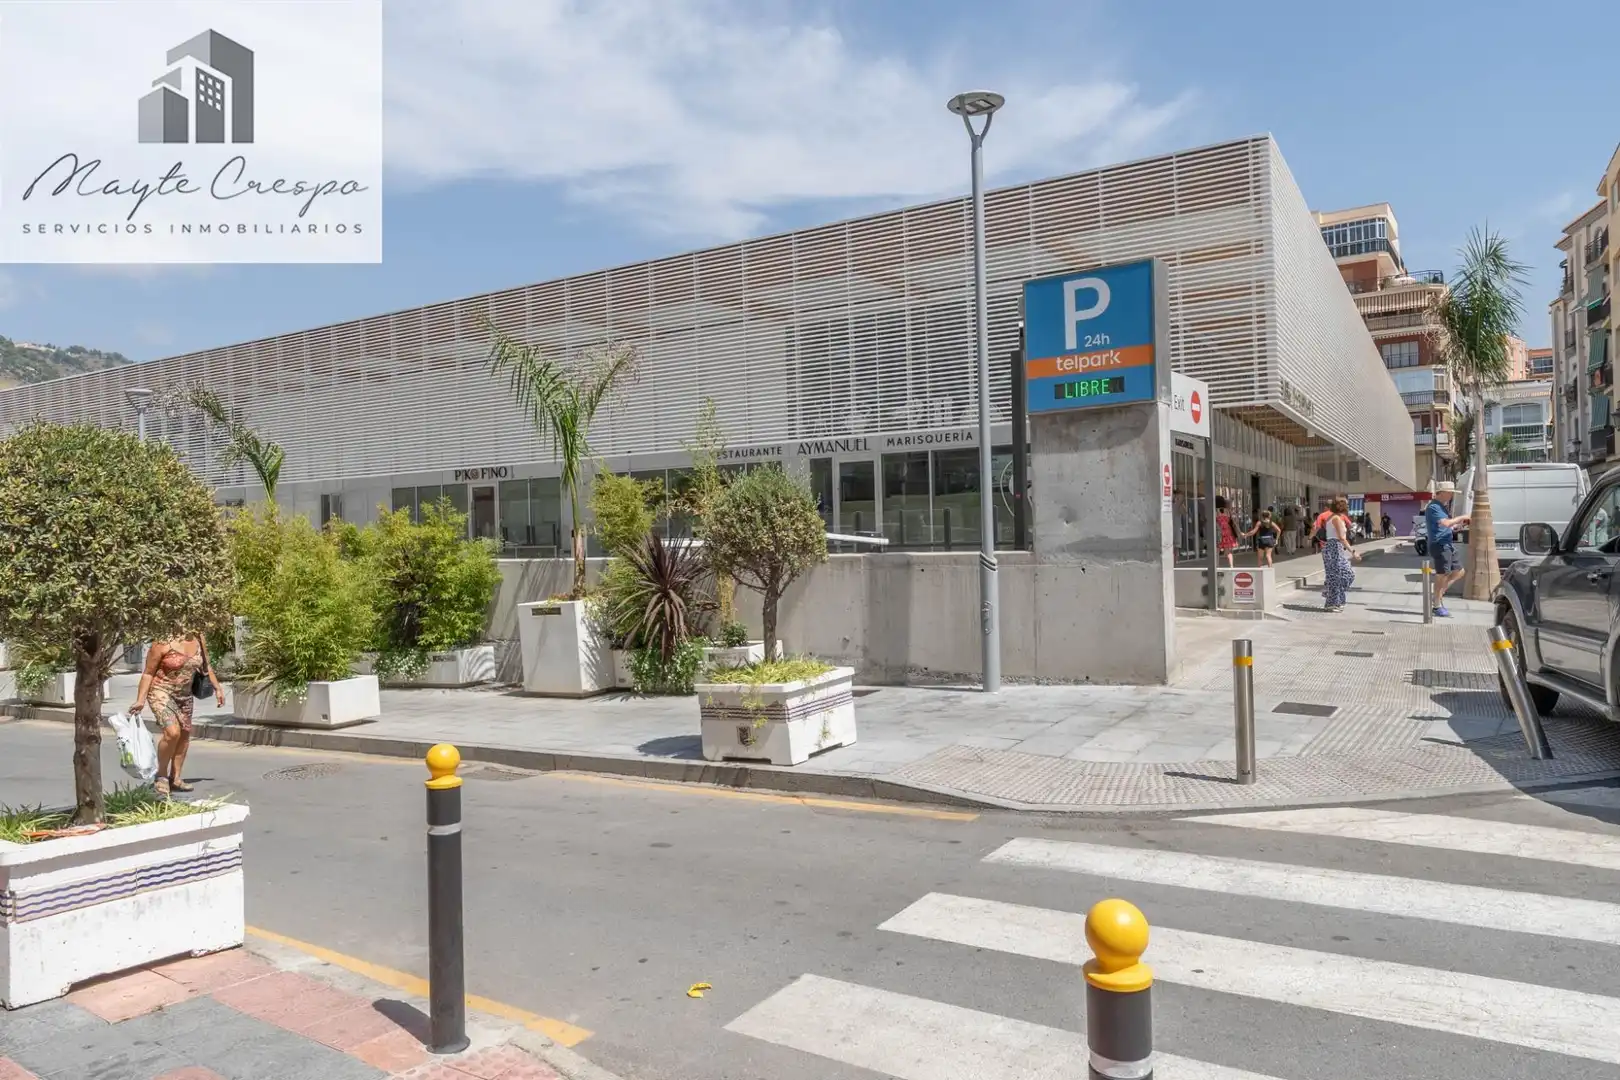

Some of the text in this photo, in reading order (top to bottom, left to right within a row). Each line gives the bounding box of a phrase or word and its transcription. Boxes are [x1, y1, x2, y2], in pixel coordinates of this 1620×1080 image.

[1063, 277, 1111, 350] P
[1084, 333, 1110, 347] 24h
[1056, 350, 1121, 372] telpark
[1064, 378, 1111, 399] LIBRE
[716, 431, 973, 460] ESTAURANTE AYMANUEL MARISQUERÍA
